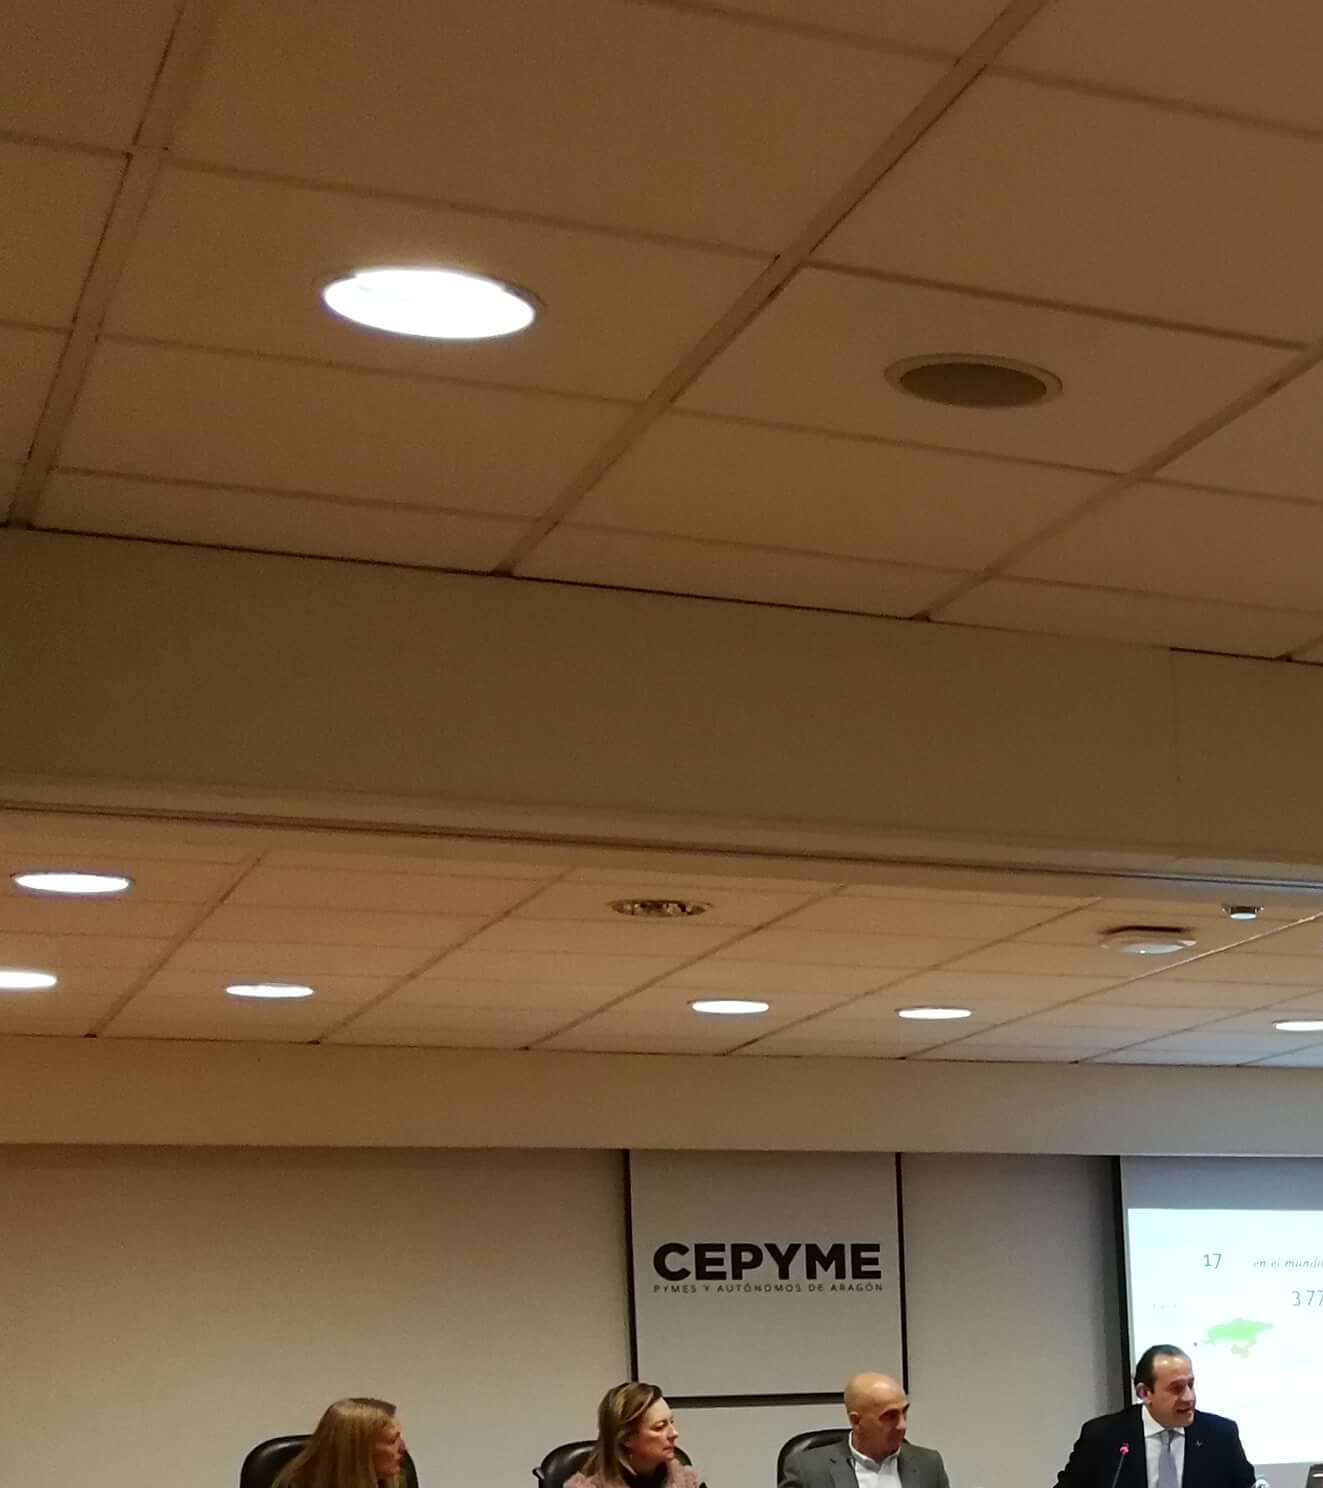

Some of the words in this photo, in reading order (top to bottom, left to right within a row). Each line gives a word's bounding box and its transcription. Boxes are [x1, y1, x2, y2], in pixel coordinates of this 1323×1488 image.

[653, 1242, 882, 1281] CEPYME
[653, 1284, 697, 1293] PYMES
[808, 1283, 824, 1292] DE
[830, 1282, 883, 1292] ARAGÓN
